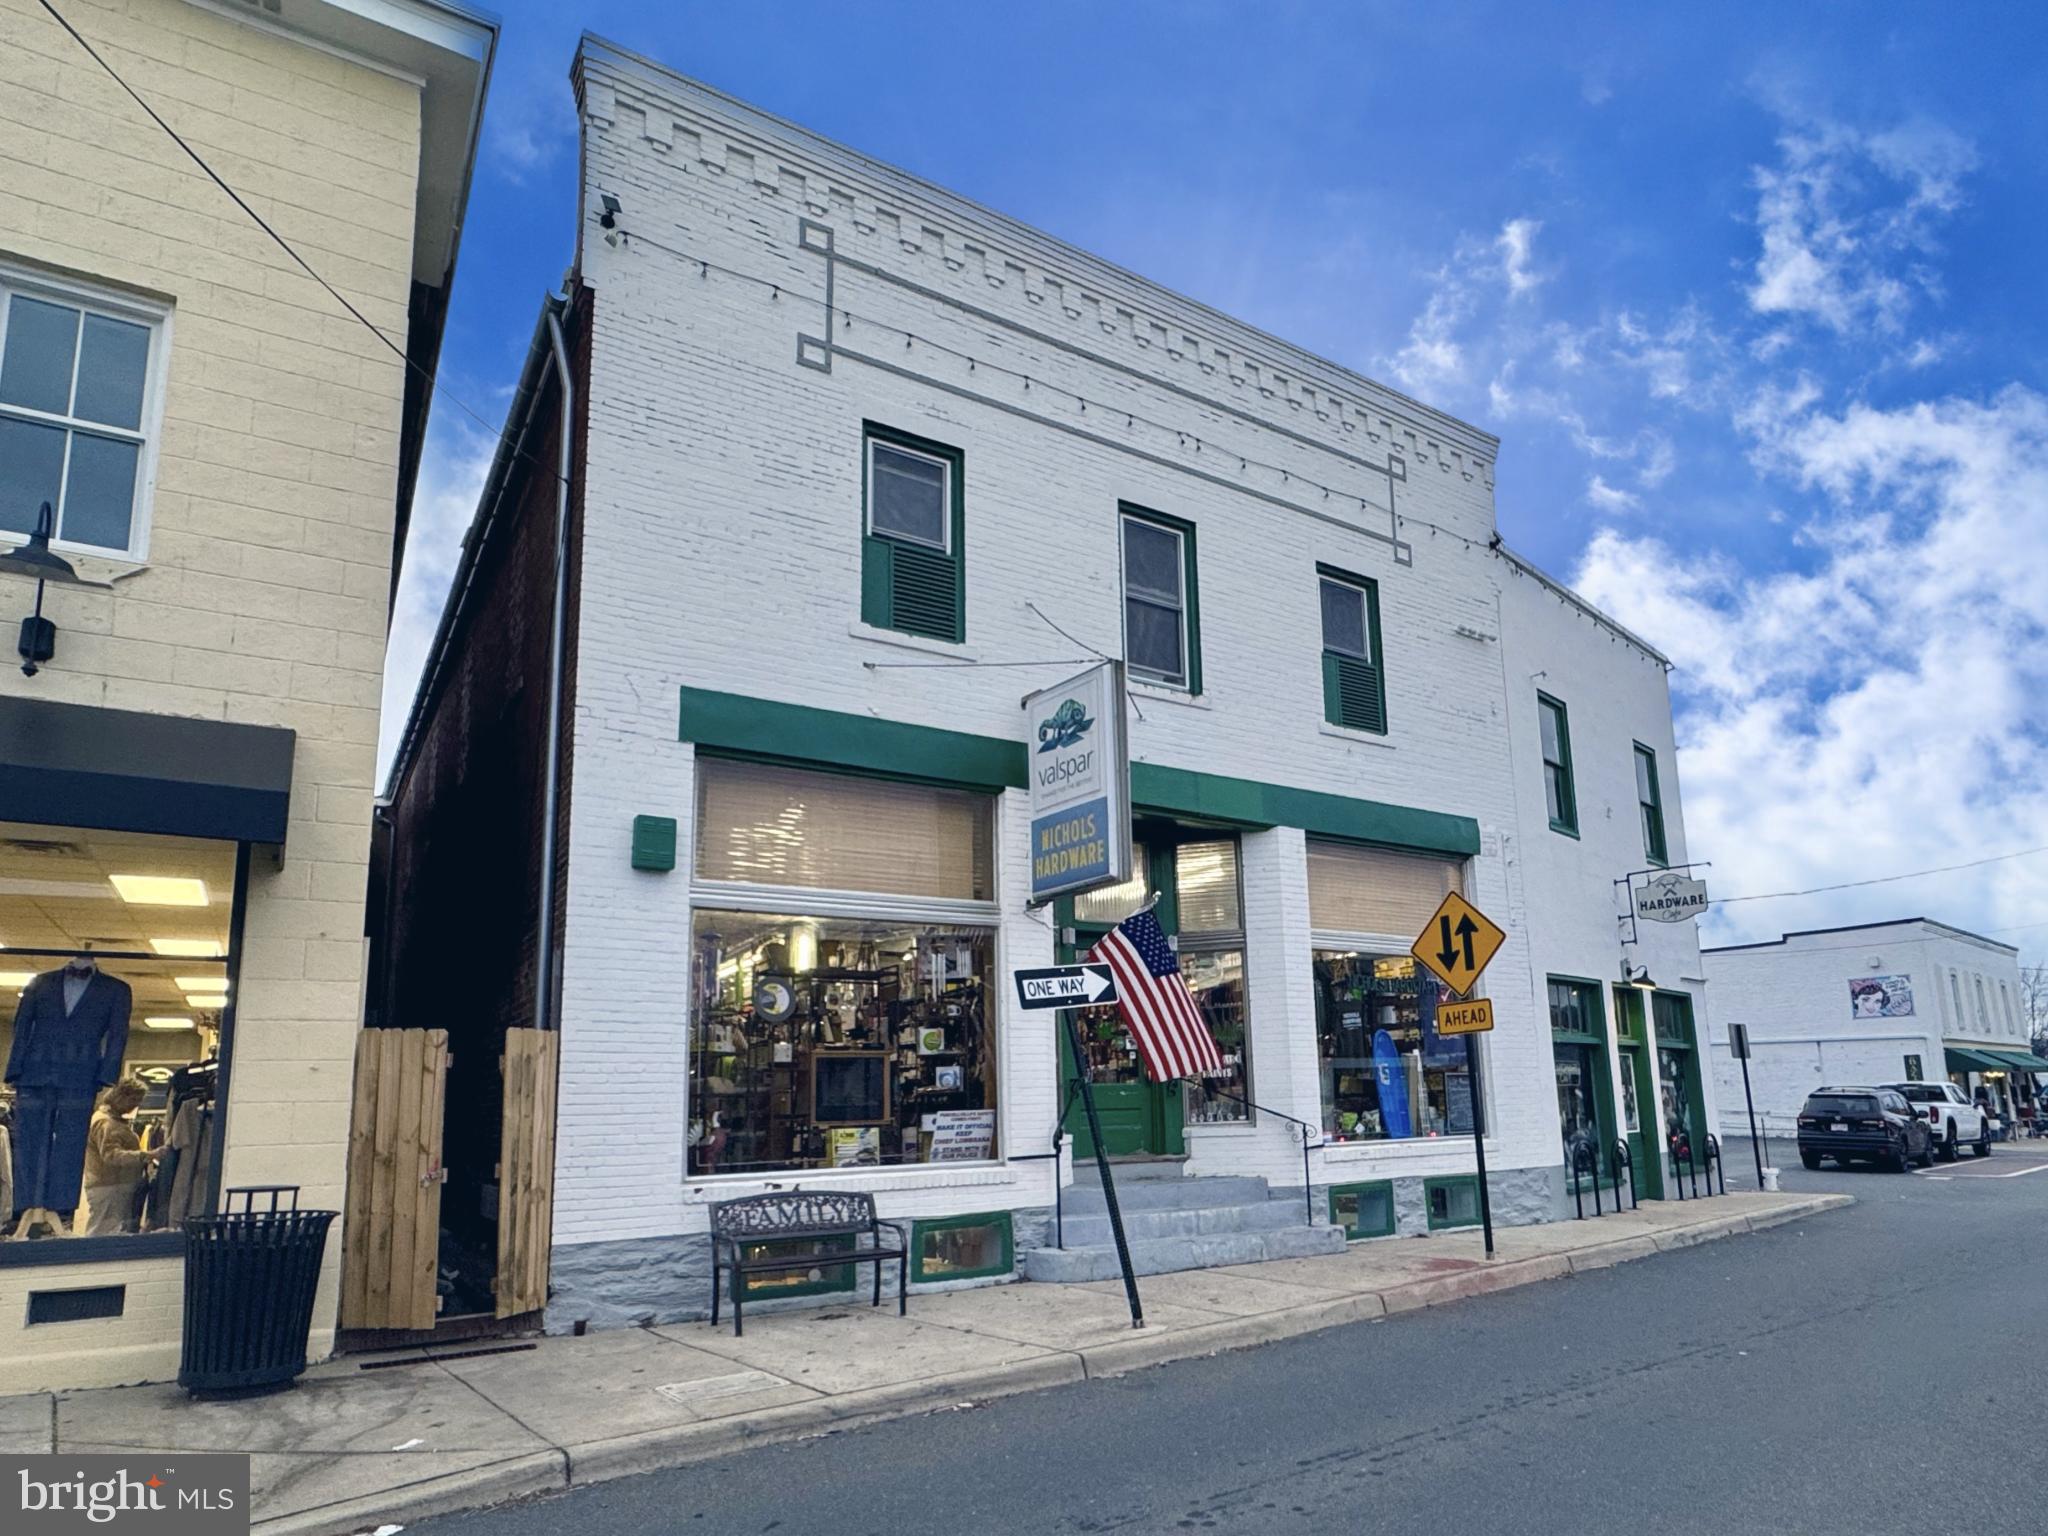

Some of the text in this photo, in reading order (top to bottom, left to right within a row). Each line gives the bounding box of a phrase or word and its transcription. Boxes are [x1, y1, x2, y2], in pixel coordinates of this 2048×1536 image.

[1038, 750, 1094, 787] valspar
[1041, 813, 1096, 852] NICHOLS
[1035, 839, 1104, 879] HARDWARE
[1640, 894, 1705, 911] HARDWARE
[1027, 978, 1085, 997] ONE WAY
[1445, 1008, 1486, 1027] AHEAD
[741, 1198, 847, 1226] FAMILY
